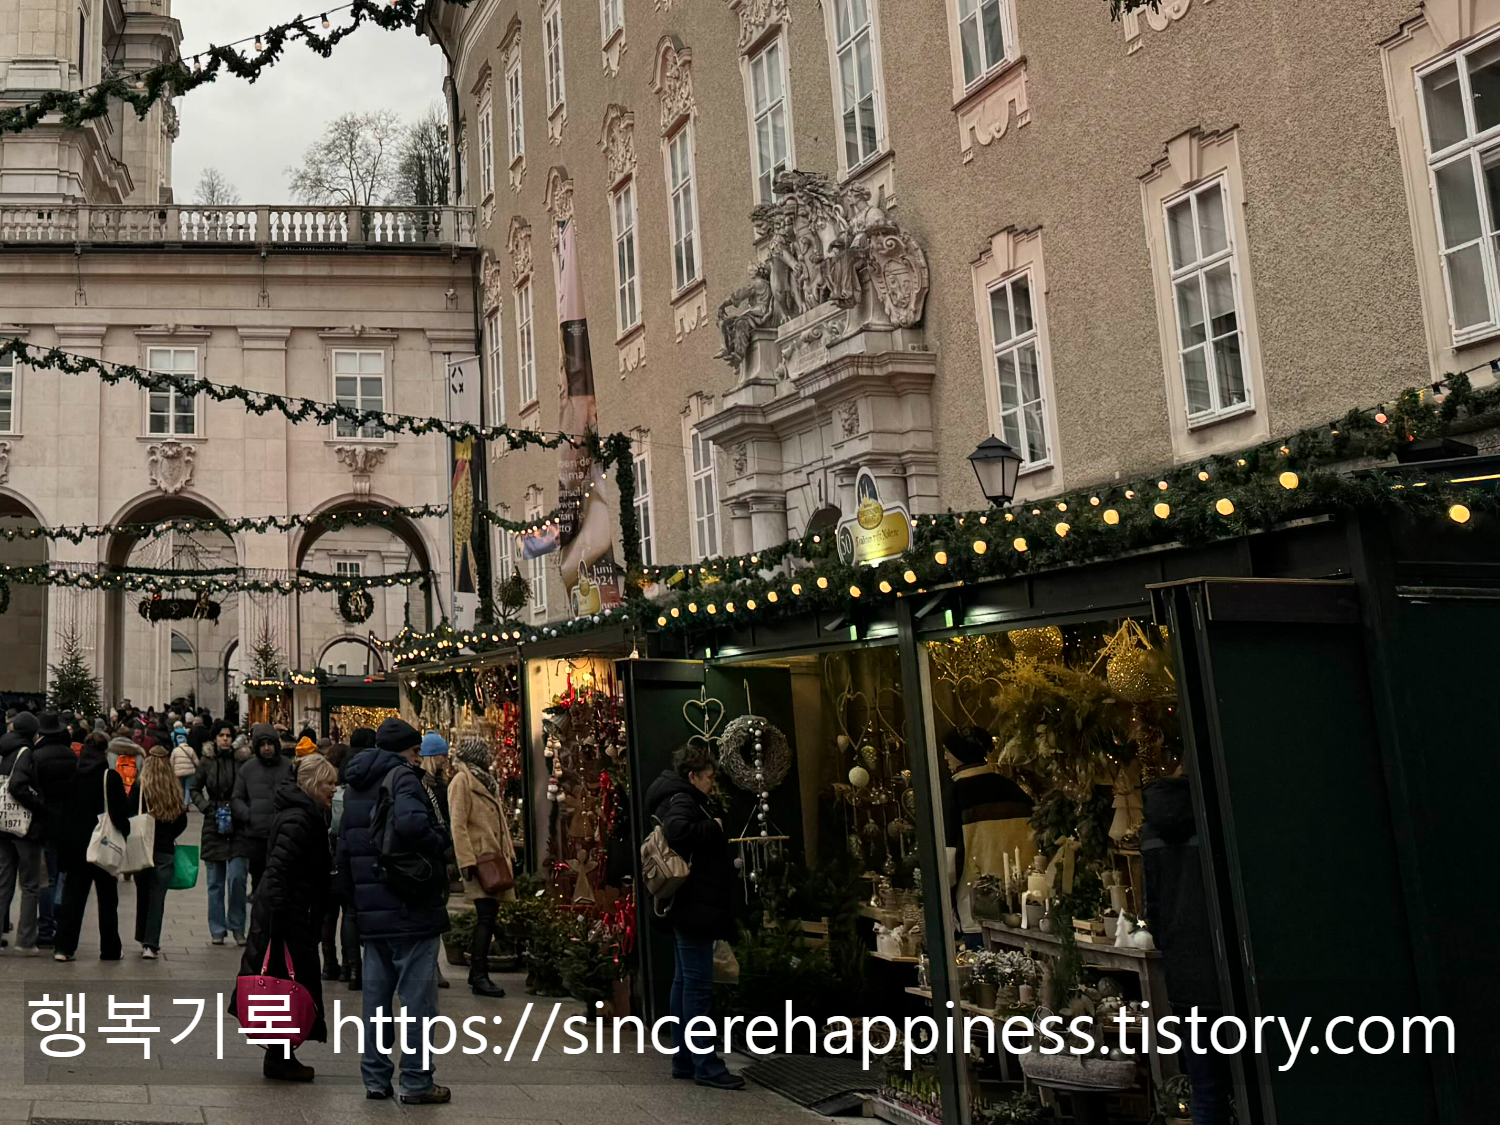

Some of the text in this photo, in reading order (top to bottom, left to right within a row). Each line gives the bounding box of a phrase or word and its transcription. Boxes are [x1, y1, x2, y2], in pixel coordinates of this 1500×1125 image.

[840, 533, 852, 556] 50
[3, 803, 20, 811] 1971
[4, 819, 22, 828] 1971
